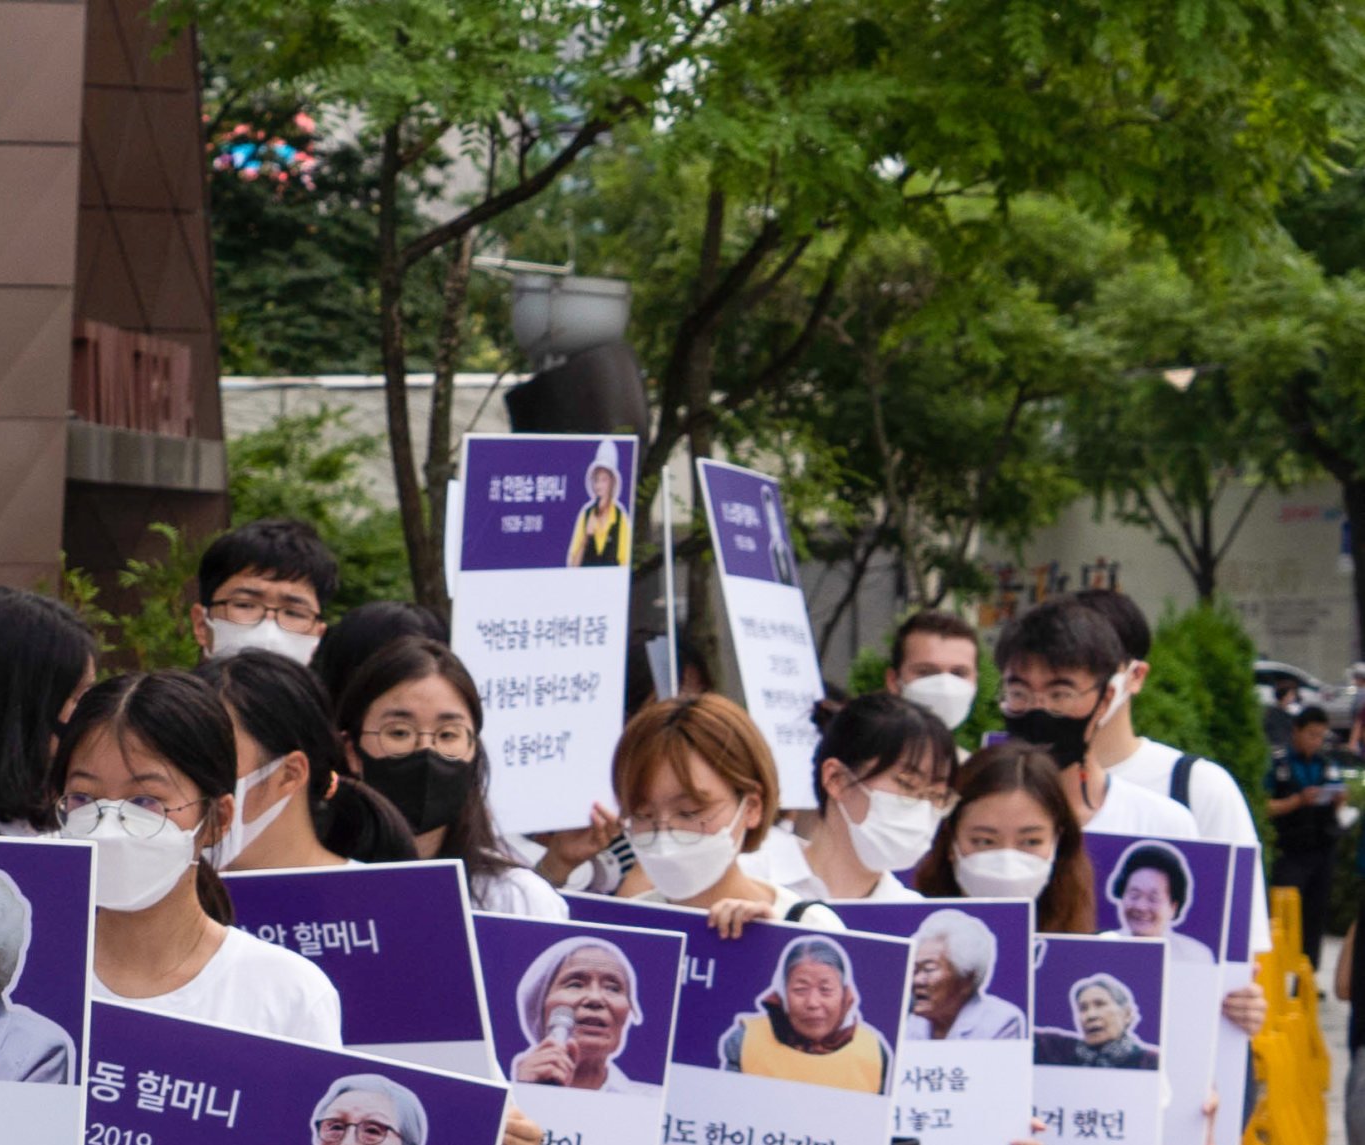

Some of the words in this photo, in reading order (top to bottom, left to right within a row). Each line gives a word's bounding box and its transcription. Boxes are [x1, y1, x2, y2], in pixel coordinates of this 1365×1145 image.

[292, 919, 379, 957] 할머니
[88, 1058, 127, 1103] 동
[136, 1069, 241, 1129] 할머니
[901, 1066, 969, 1092] 사람을
[907, 1107, 953, 1131] 놓고
[1032, 1105, 1064, 1137] 겨
[1072, 1109, 1125, 1140] 했던
